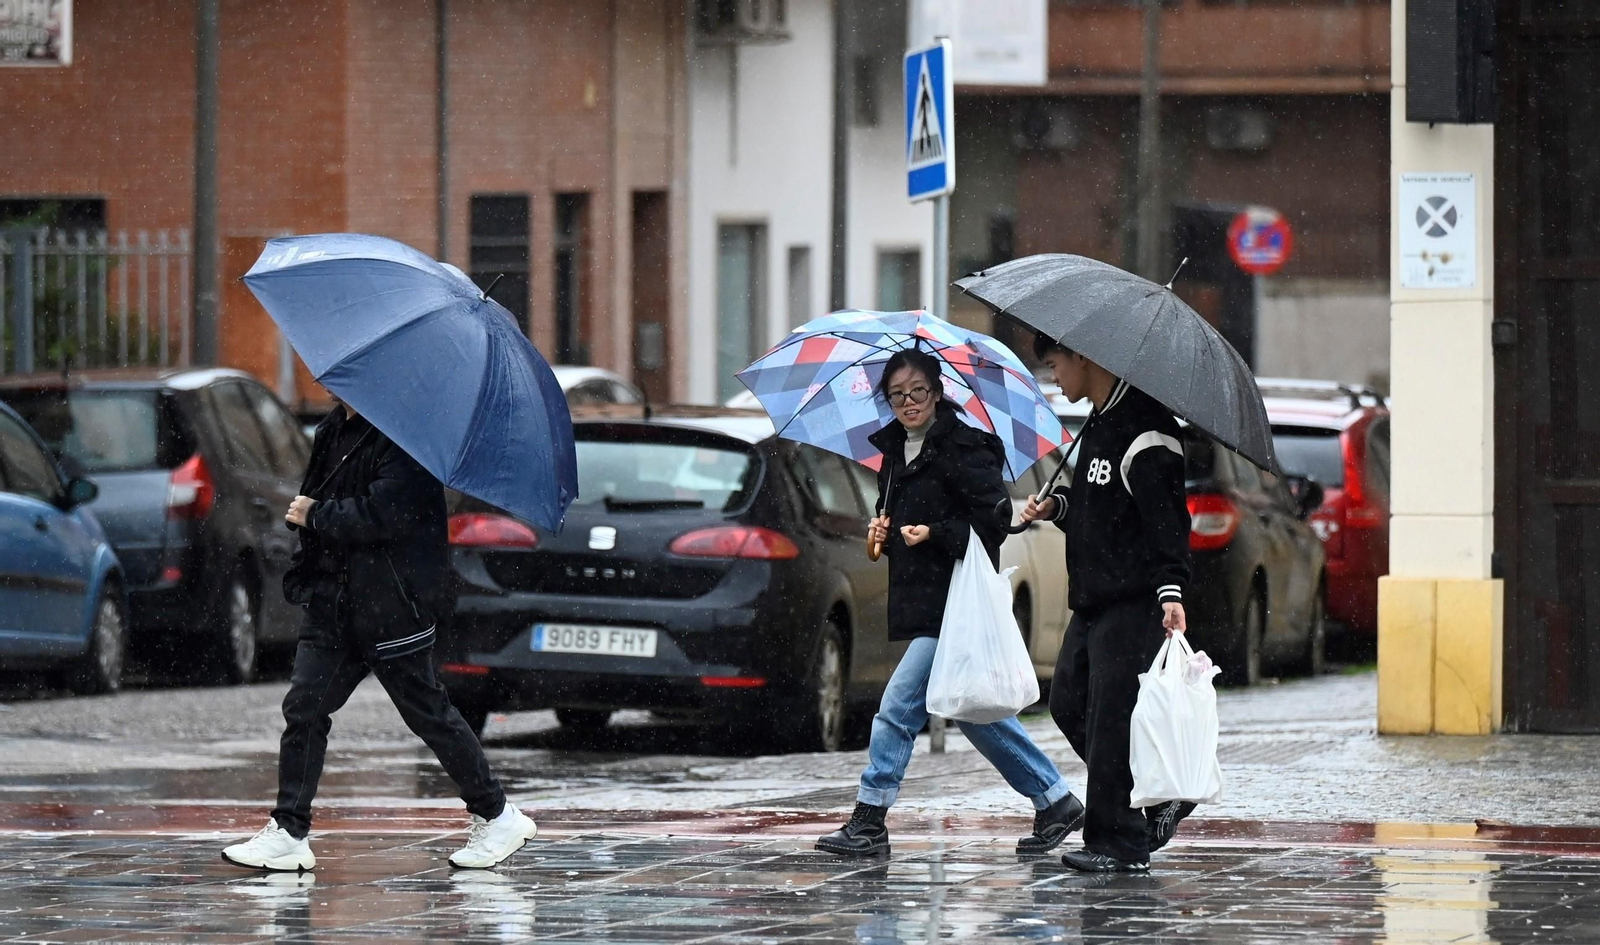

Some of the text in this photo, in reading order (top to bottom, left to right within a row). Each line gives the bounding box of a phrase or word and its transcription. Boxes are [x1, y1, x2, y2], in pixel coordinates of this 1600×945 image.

[566, 567, 636, 578] LEON
[548, 627, 649, 652] 9089 FHY
